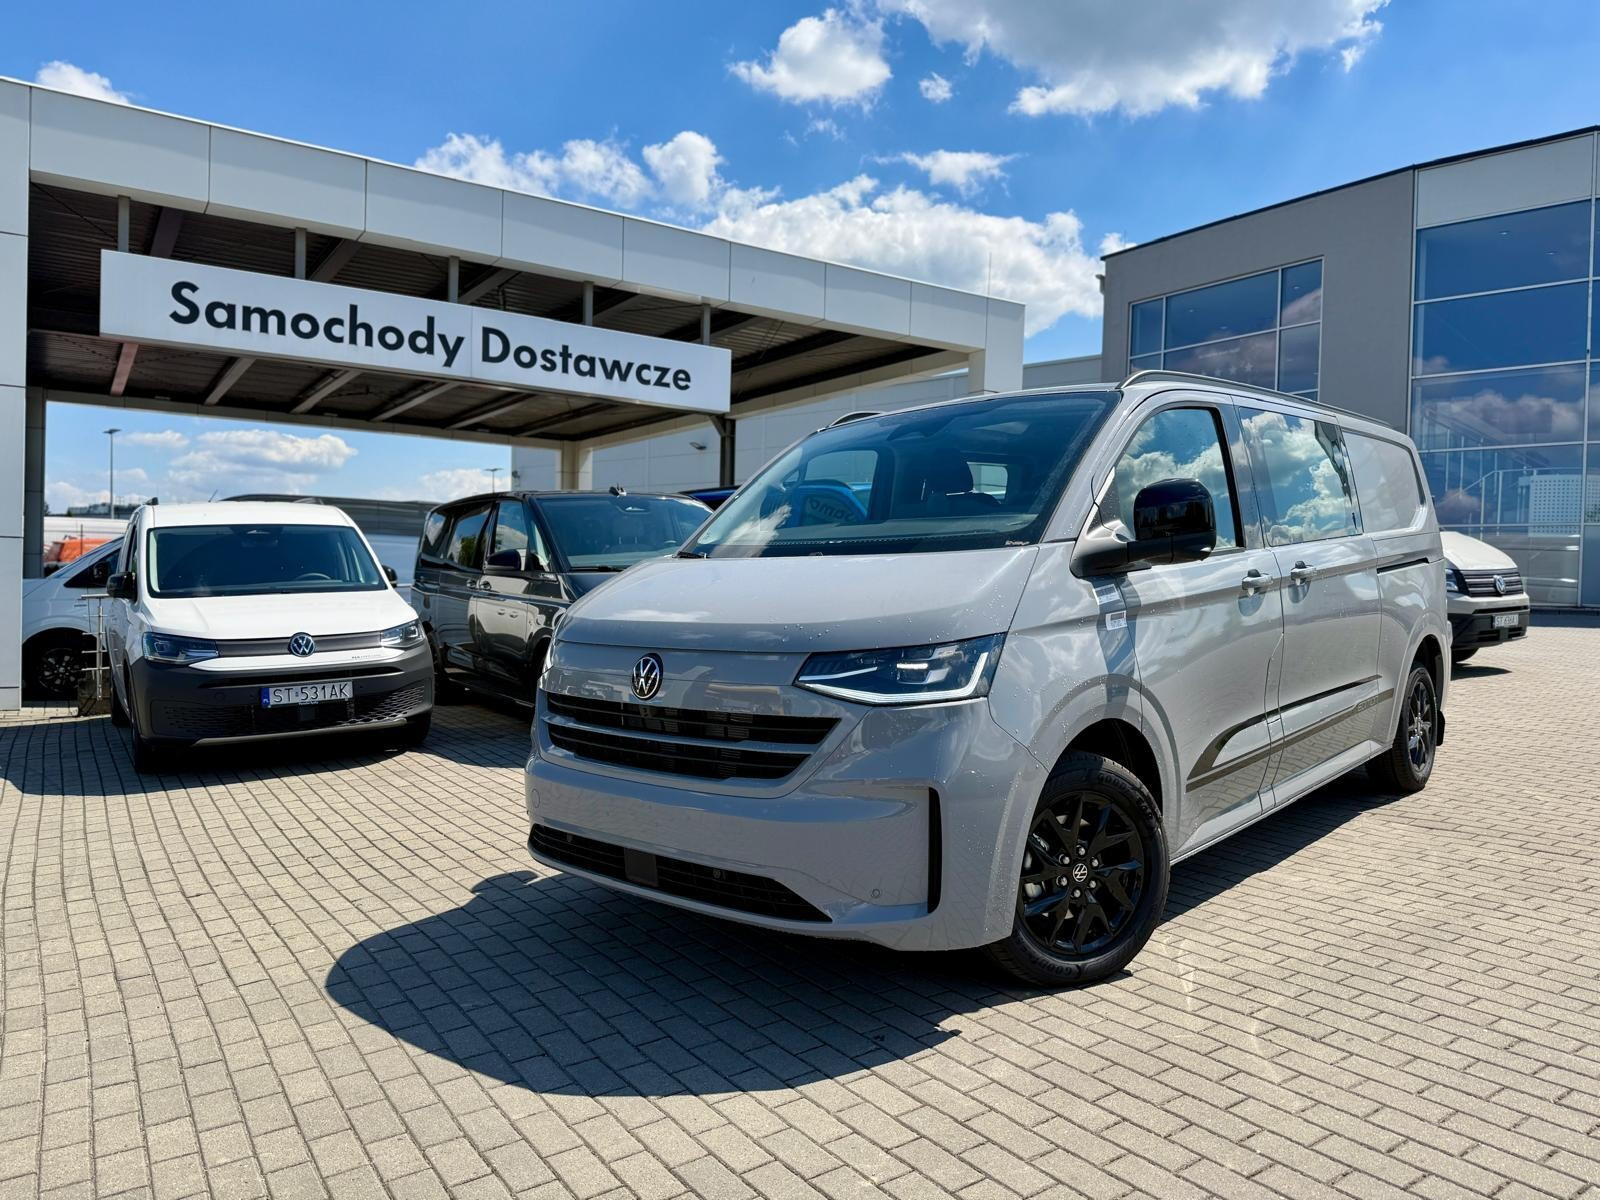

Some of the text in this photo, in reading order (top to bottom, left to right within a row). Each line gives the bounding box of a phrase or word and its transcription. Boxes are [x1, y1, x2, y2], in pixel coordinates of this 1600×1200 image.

[169, 281, 691, 391] Samochody Dostawcze
[273, 683, 349, 703] ST 531AK
